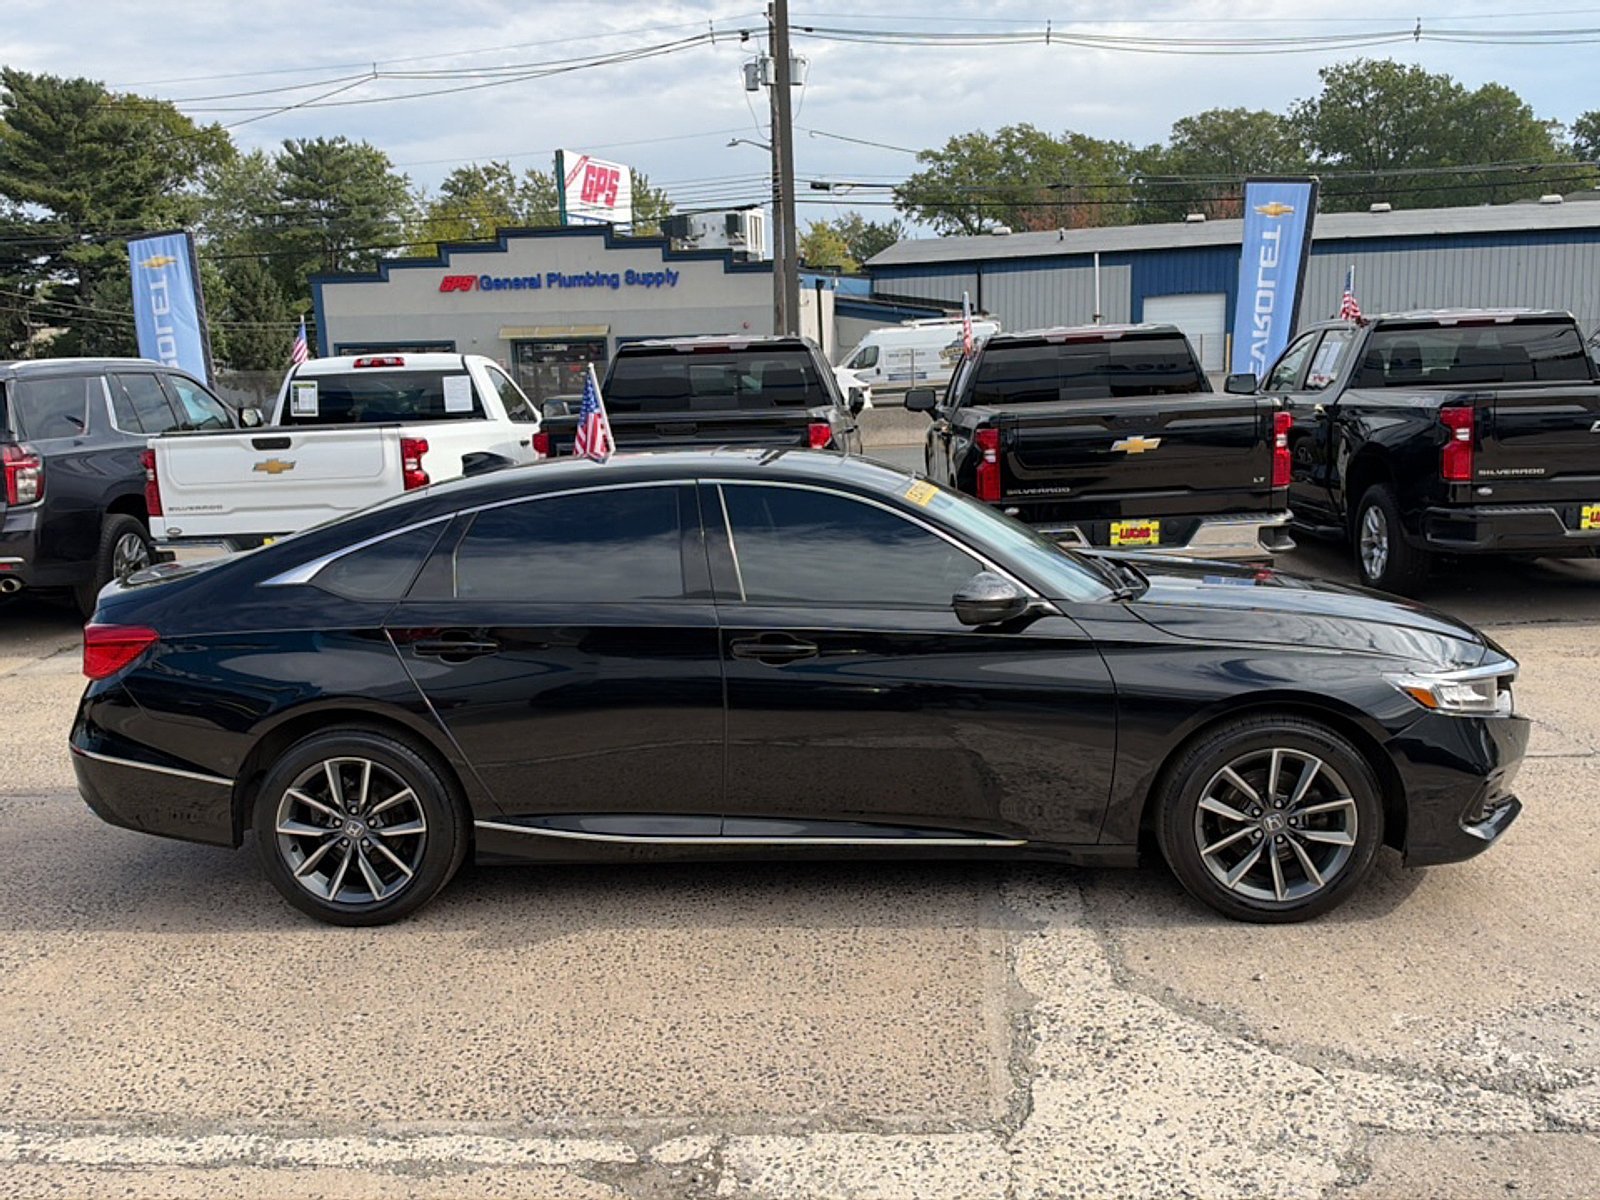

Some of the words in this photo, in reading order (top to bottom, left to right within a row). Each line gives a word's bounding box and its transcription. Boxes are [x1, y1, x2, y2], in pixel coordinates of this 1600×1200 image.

[580, 164, 620, 208] GPS
[439, 275, 477, 293] GPS
[479, 274, 541, 291] General
[547, 271, 620, 290] Plumbing
[624, 268, 680, 288] Supply
[1478, 468, 1545, 476] SILVERADO
[1120, 526, 1151, 540] LUCAS
